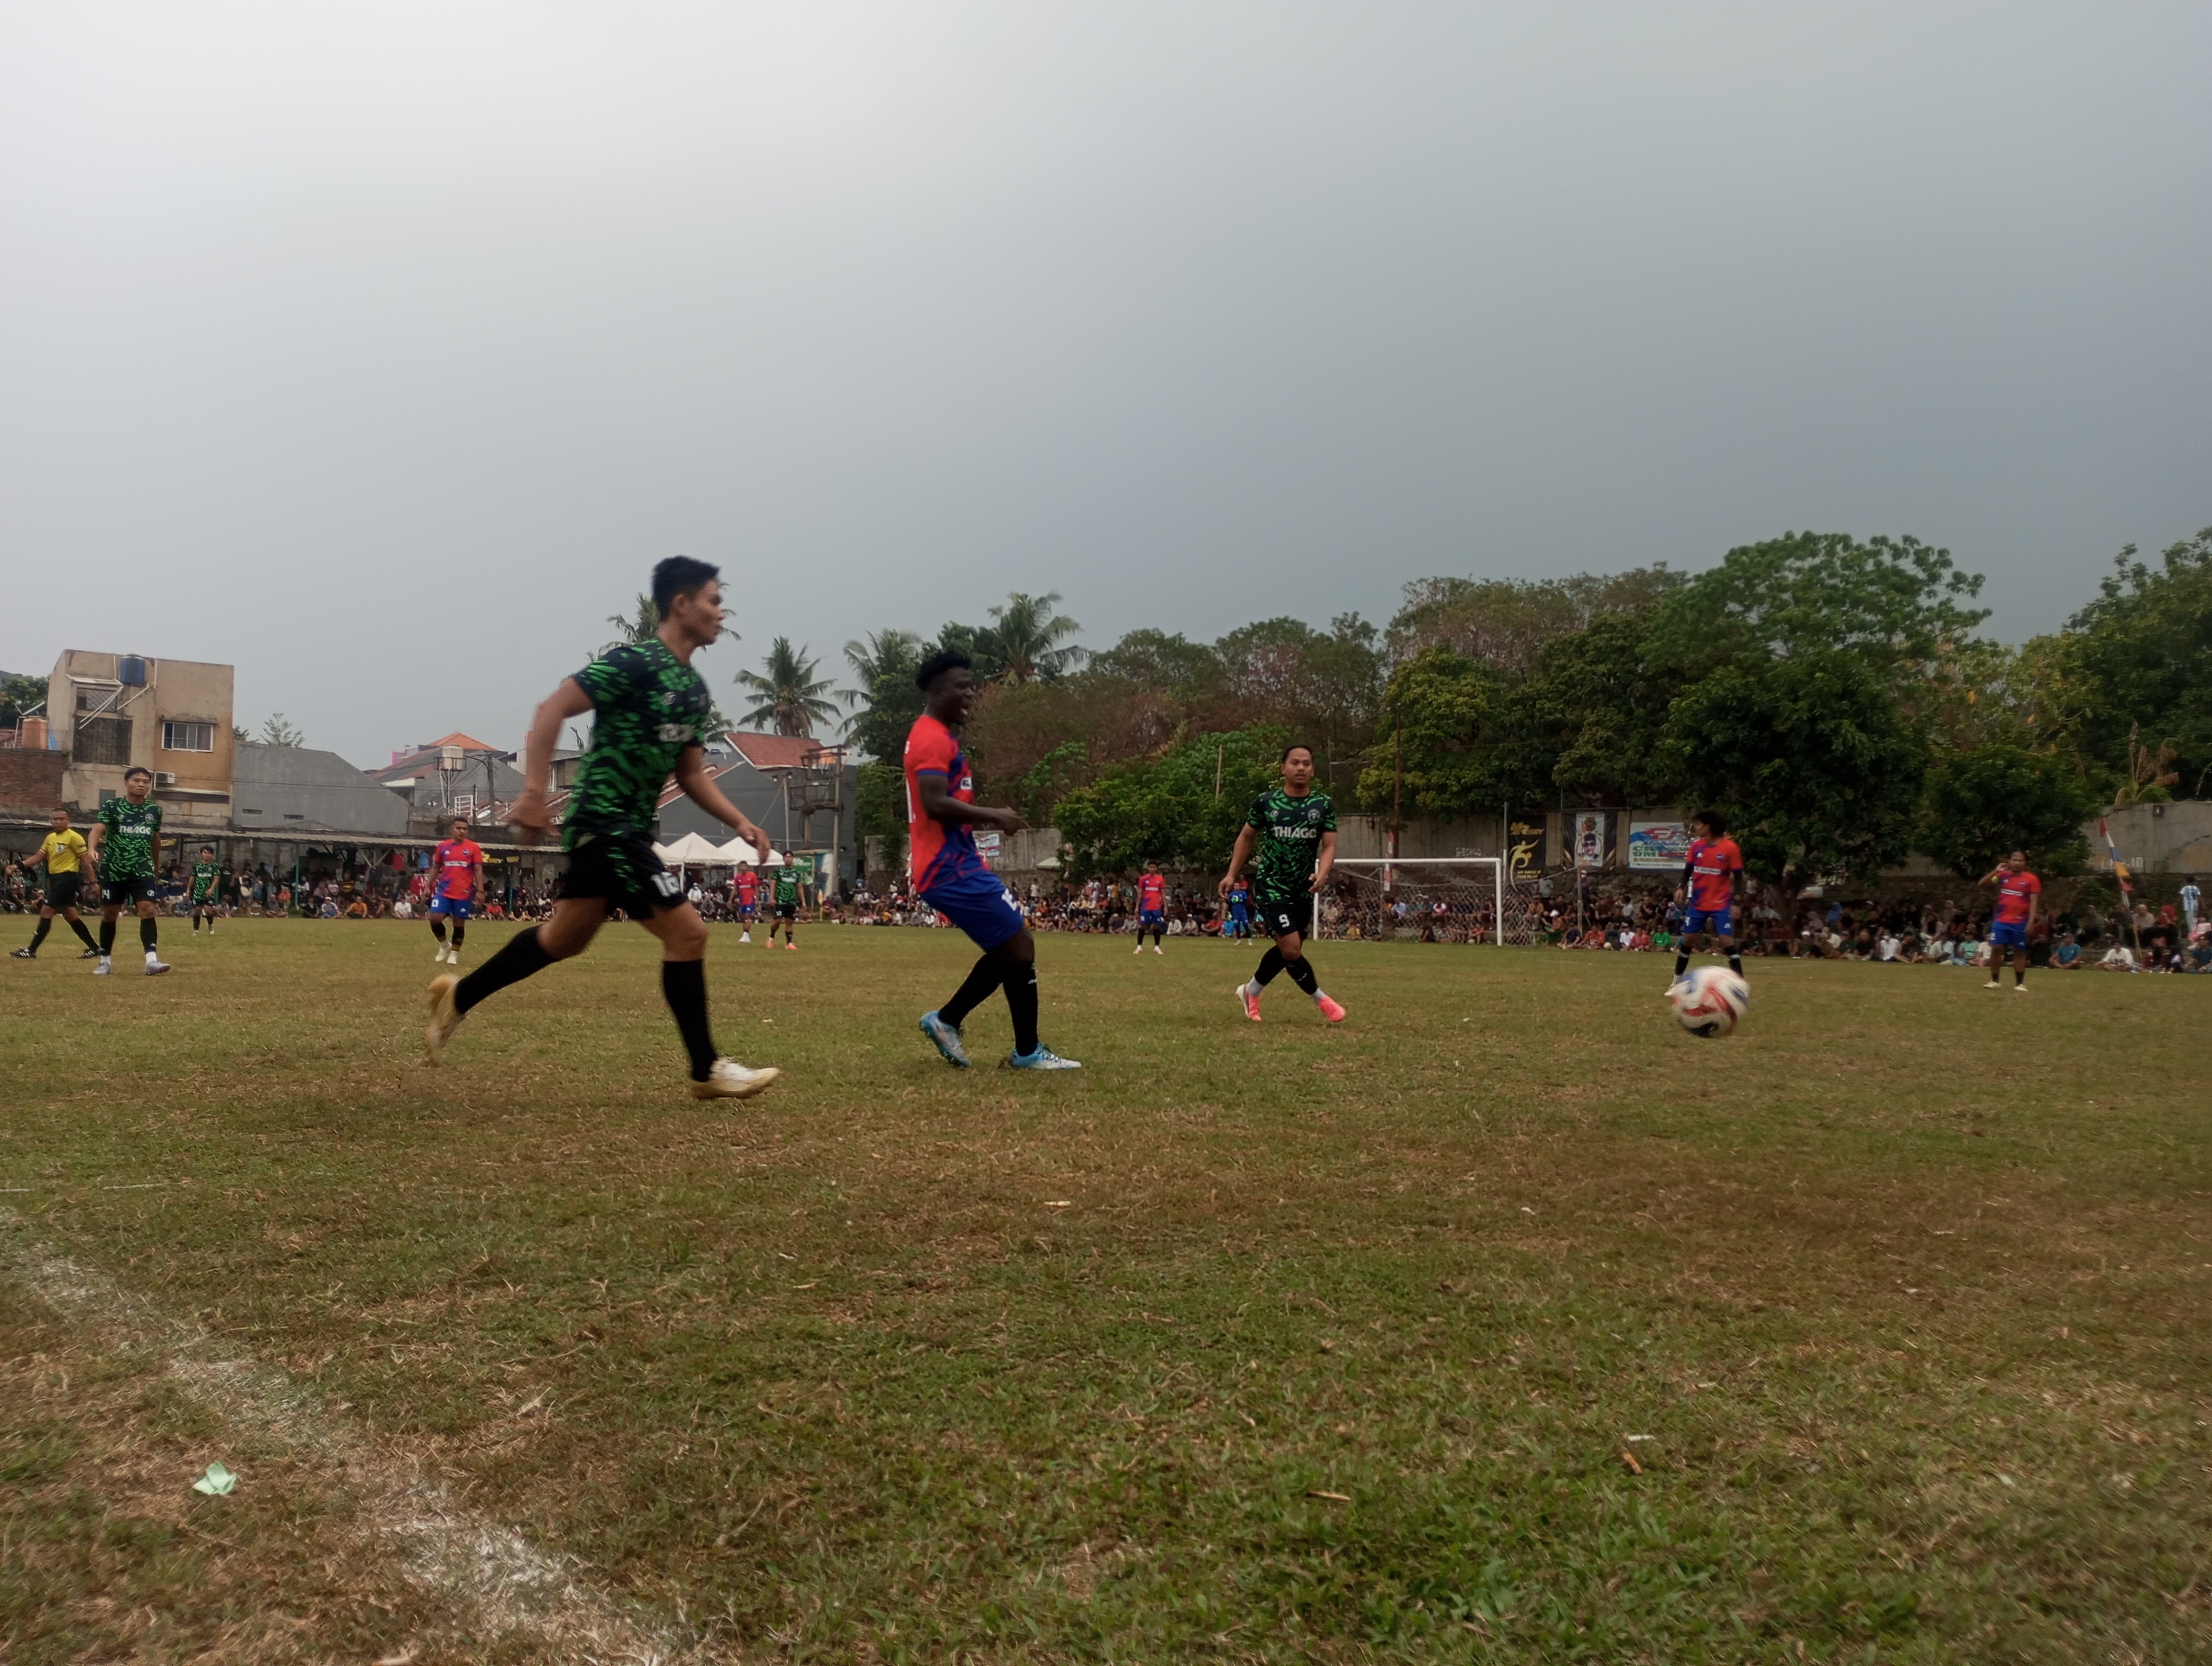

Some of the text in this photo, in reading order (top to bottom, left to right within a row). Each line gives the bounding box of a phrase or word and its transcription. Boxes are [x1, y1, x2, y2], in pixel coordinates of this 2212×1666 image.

[1272, 825, 1317, 838] THIAGO
[101, 889, 110, 900] 14
[1278, 914, 1290, 927] 9
